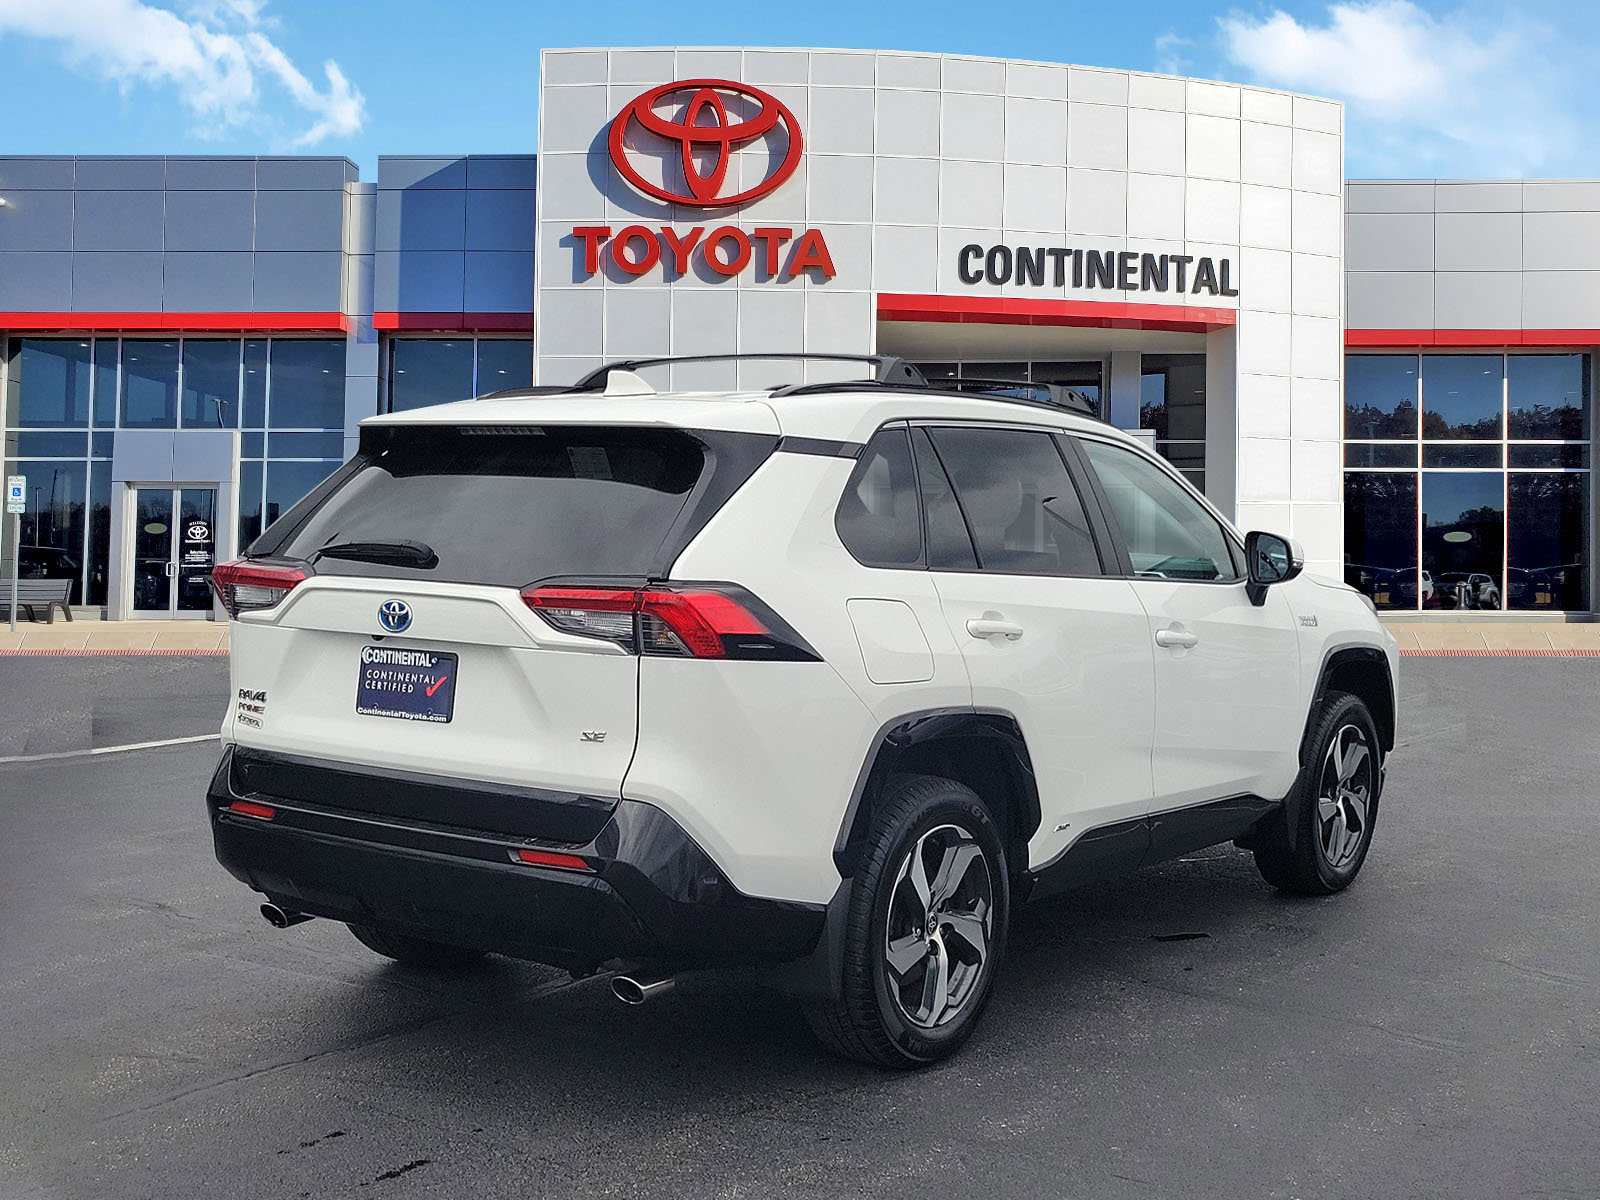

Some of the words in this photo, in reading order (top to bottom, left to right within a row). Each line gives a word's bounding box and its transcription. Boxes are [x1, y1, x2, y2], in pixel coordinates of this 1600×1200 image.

[572, 225, 836, 278] TOYOTA
[959, 243, 1239, 297] CONTINENTAL
[362, 647, 432, 667] CONTINENTAL
[366, 669, 436, 685] CONTINENTAL
[365, 680, 414, 694] CERTIFIED
[239, 688, 267, 703] RAV4
[357, 706, 447, 722] ContinentalToyota.com
[580, 730, 607, 743] SE
